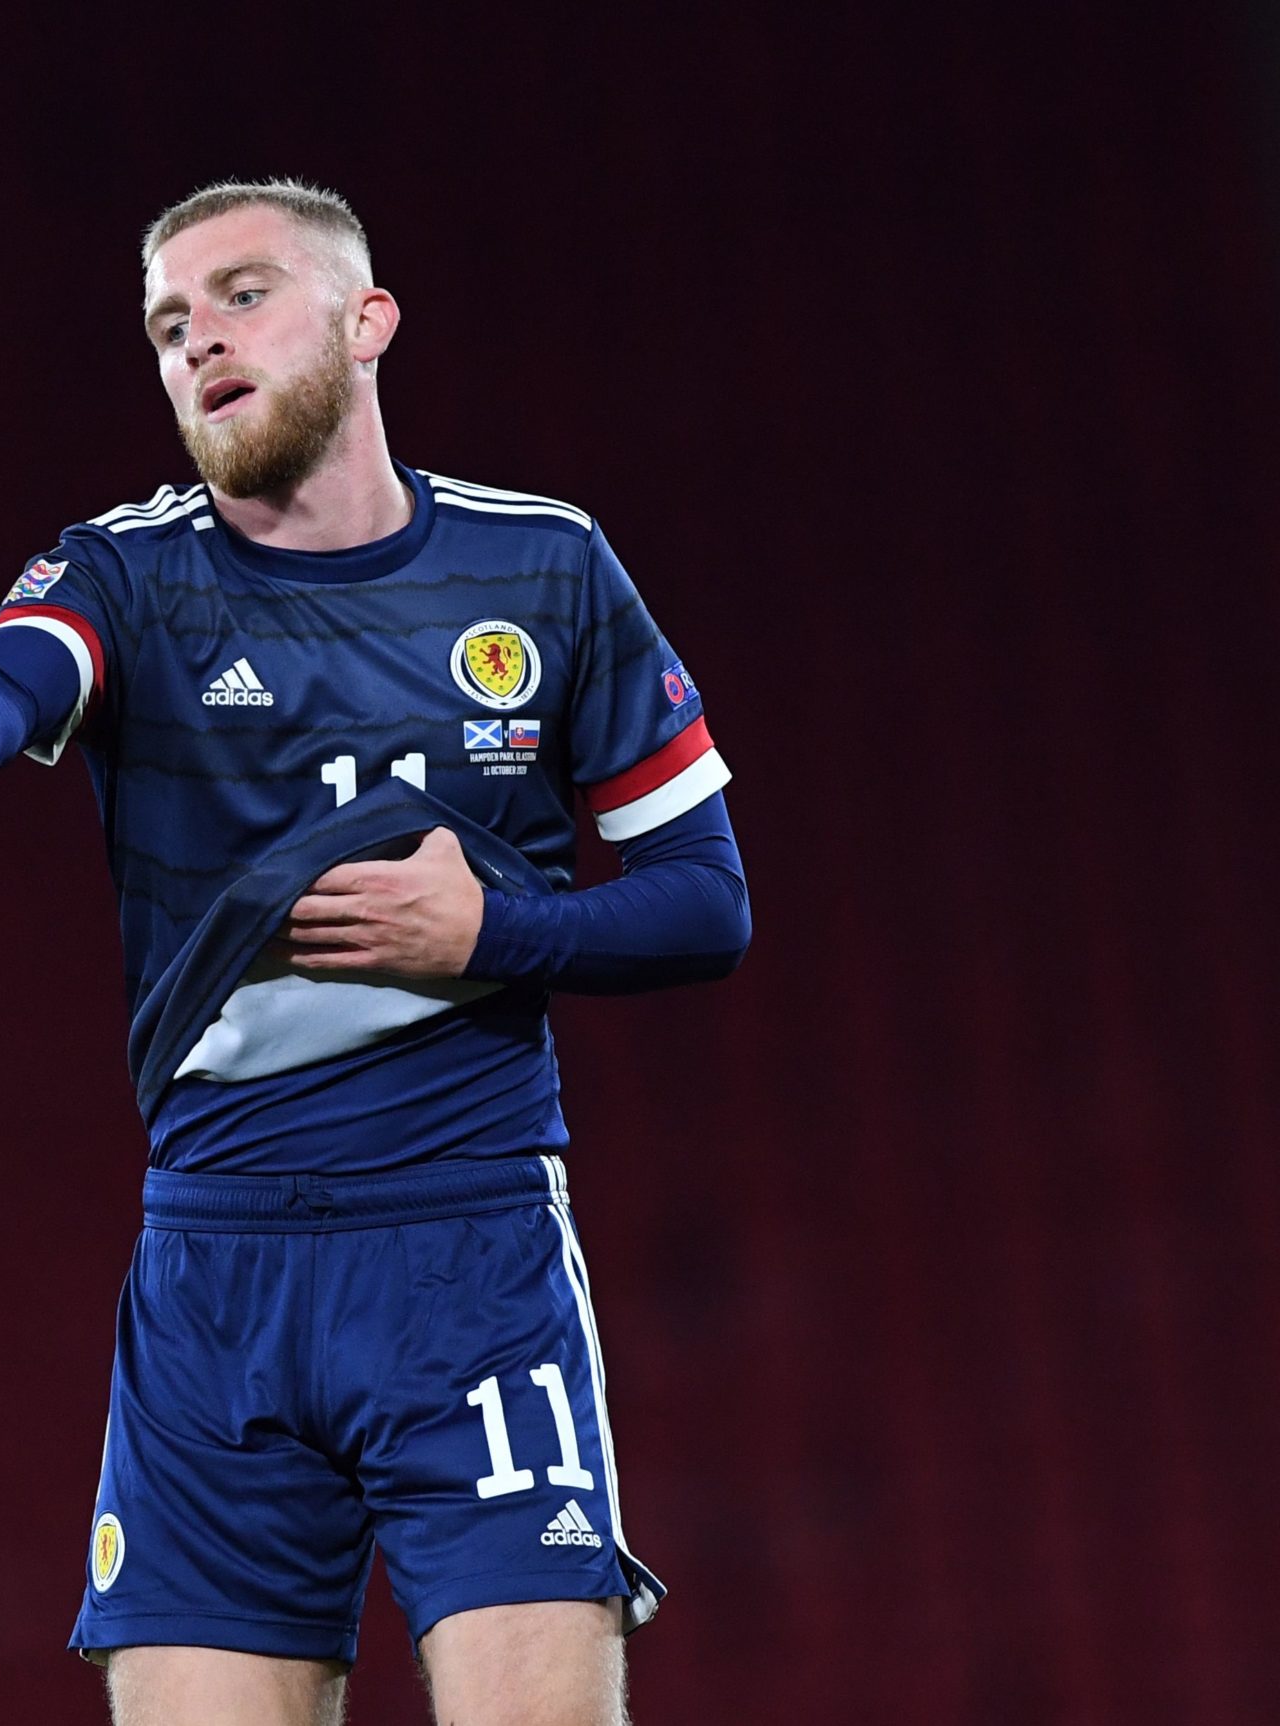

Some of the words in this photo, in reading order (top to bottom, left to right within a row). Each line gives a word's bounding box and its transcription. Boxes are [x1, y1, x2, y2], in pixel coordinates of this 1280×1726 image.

[468, 624, 513, 637] SCOTLAND
[201, 687, 274, 707] adidas
[470, 753, 498, 762] HAMPDEN
[483, 767, 490, 775] 11
[491, 766, 515, 775] OCTOBER
[466, 1363, 595, 1500] 11
[540, 1529, 603, 1549] adidas
